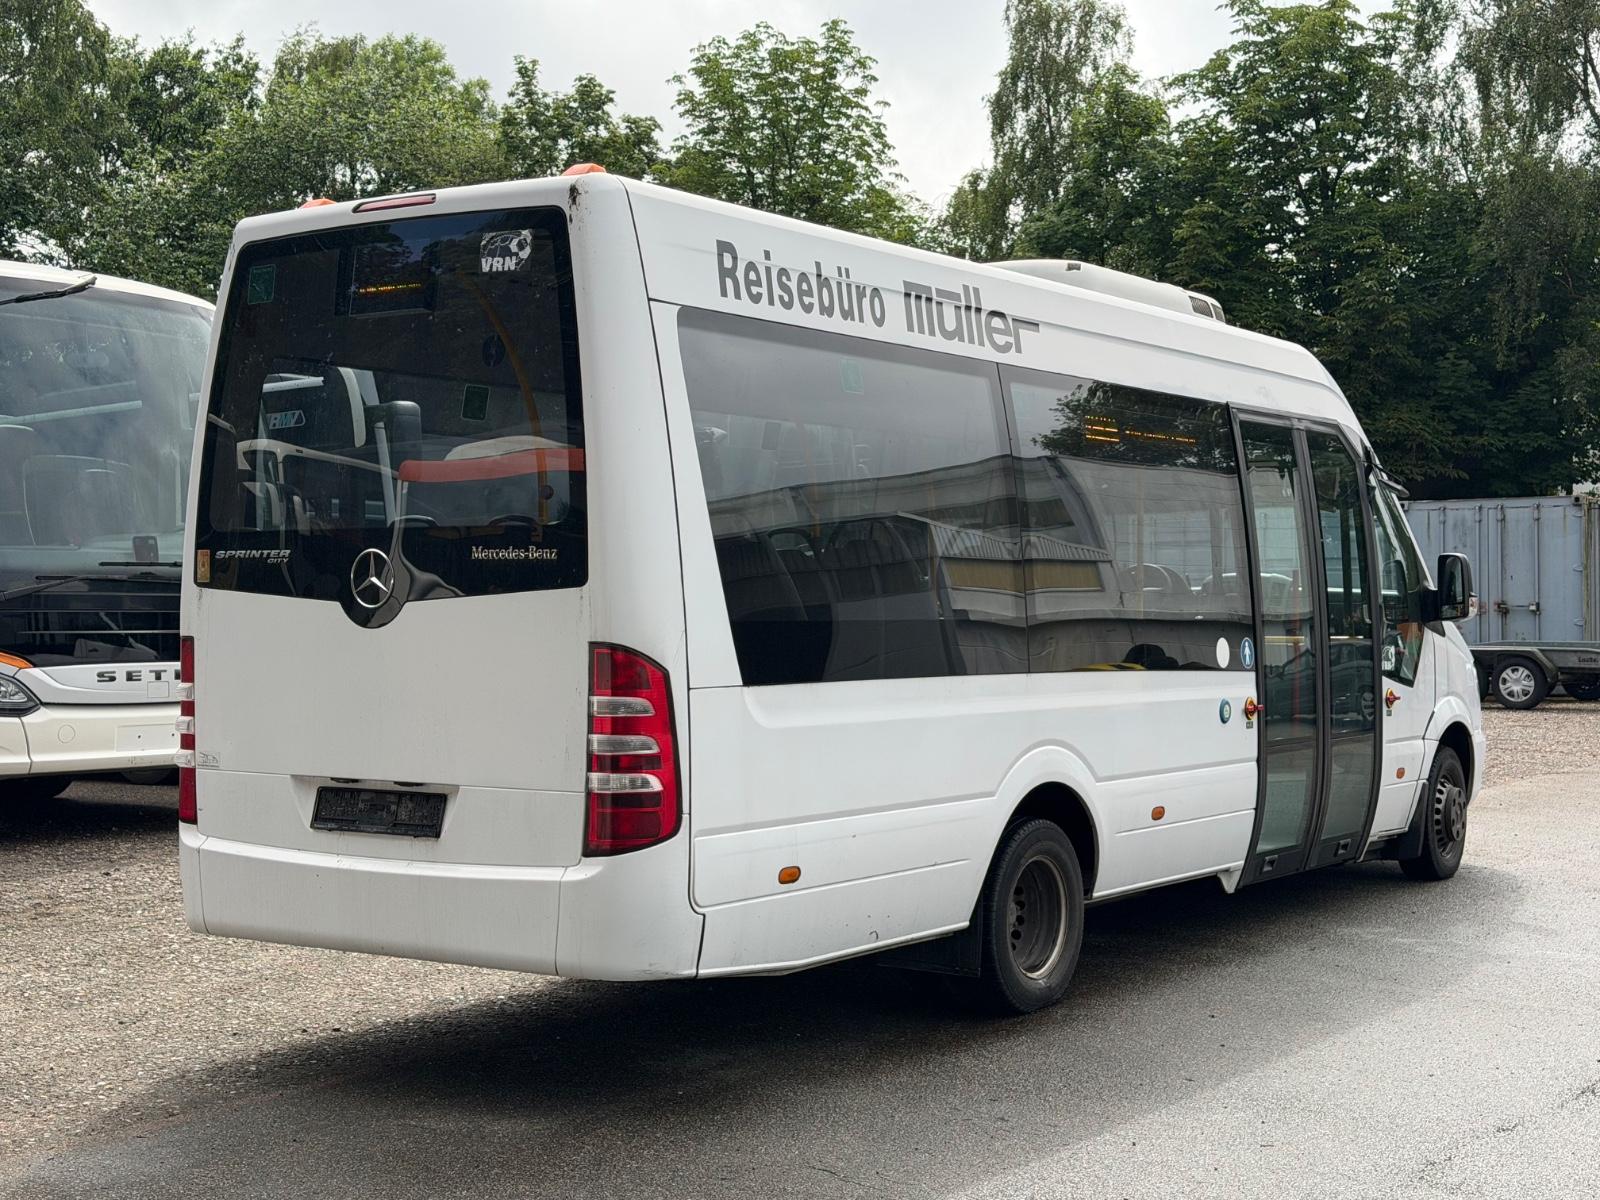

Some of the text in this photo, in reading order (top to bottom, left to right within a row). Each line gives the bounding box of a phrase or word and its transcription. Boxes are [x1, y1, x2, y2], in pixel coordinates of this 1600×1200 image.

[481, 256, 517, 272] VRN
[716, 239, 886, 328] Reisebüro
[215, 549, 291, 559] SPRINTER
[471, 545, 558, 560] Mercedes-Benz
